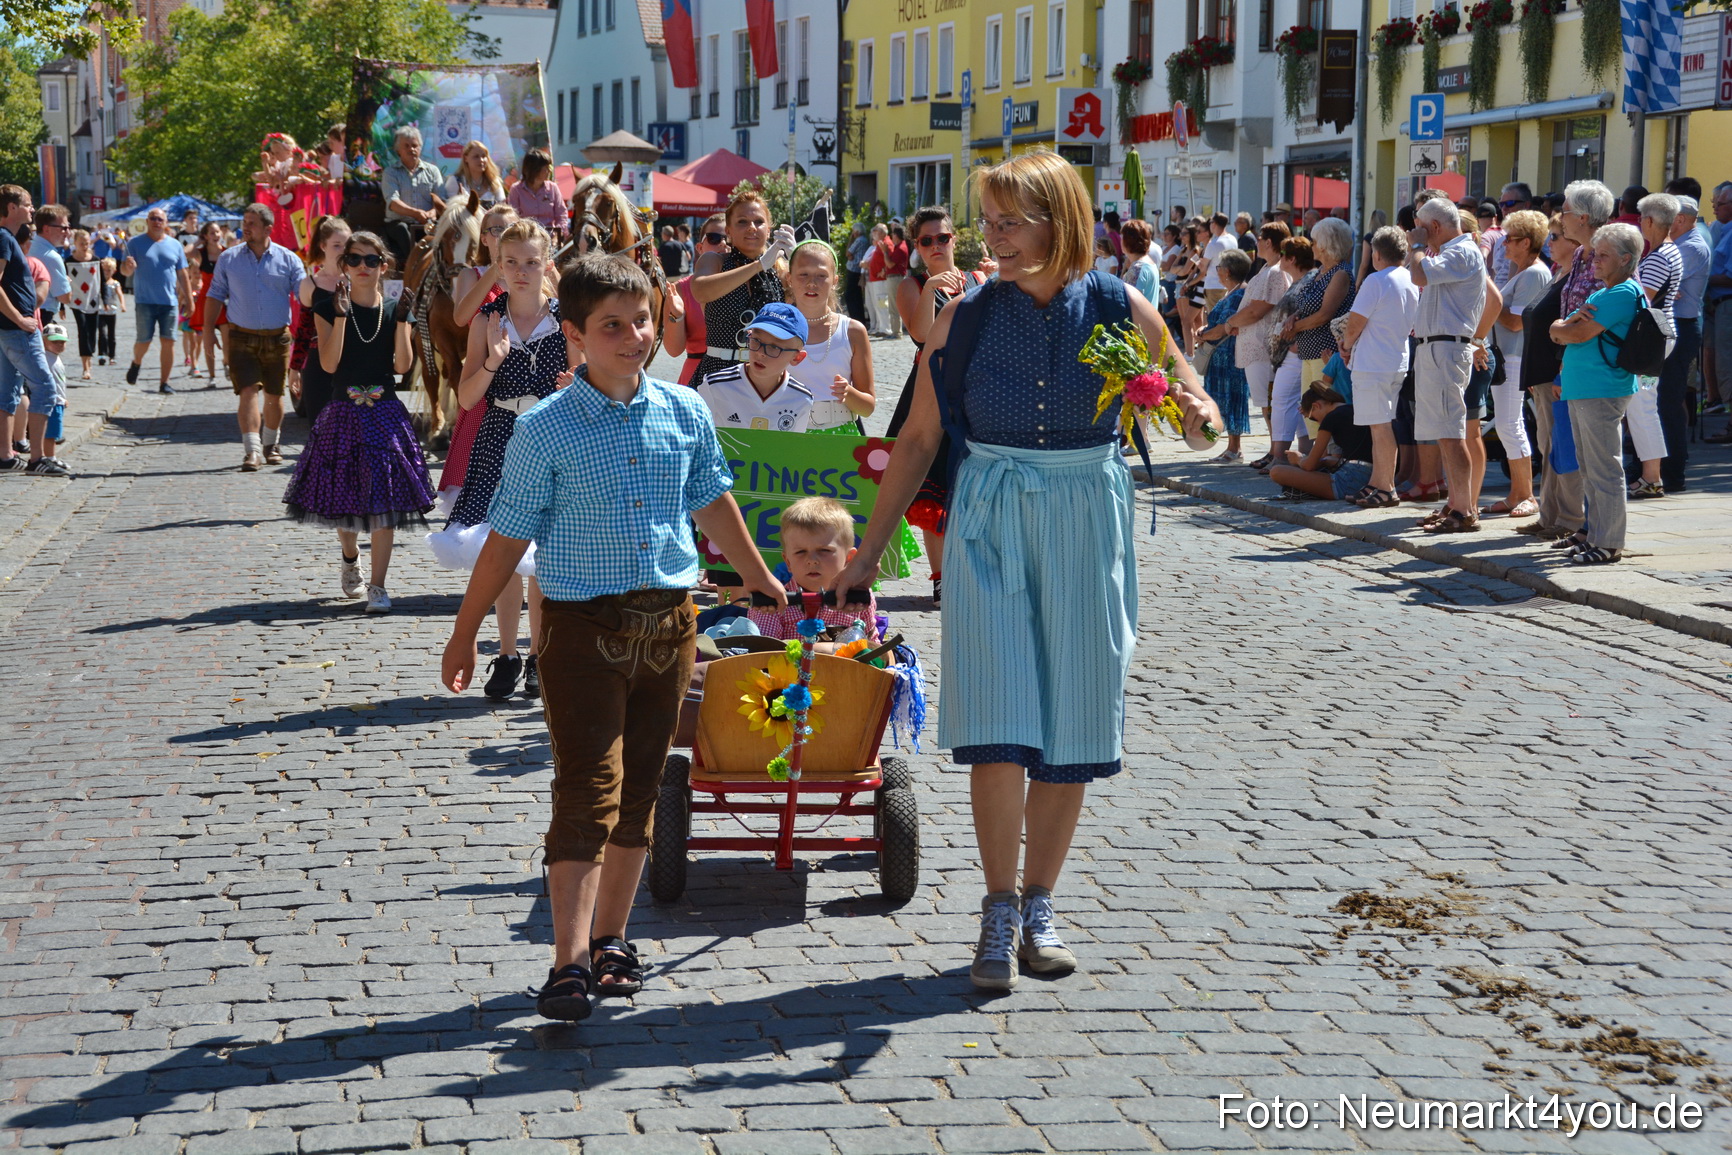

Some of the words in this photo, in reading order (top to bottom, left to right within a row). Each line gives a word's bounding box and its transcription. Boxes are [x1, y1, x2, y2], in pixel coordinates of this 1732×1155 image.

[898, 0, 928, 22] HOTEL
[1683, 53, 1705, 73] KINO
[1437, 73, 1459, 89] WOLLE
[1004, 102, 1011, 132] P
[1417, 100, 1437, 136] P
[653, 126, 680, 152] KL
[893, 133, 934, 152] Restaurant
[1420, 146, 1432, 154] nur
[1192, 158, 1213, 169] APOTHEKE
[726, 459, 859, 500] FITNESS
